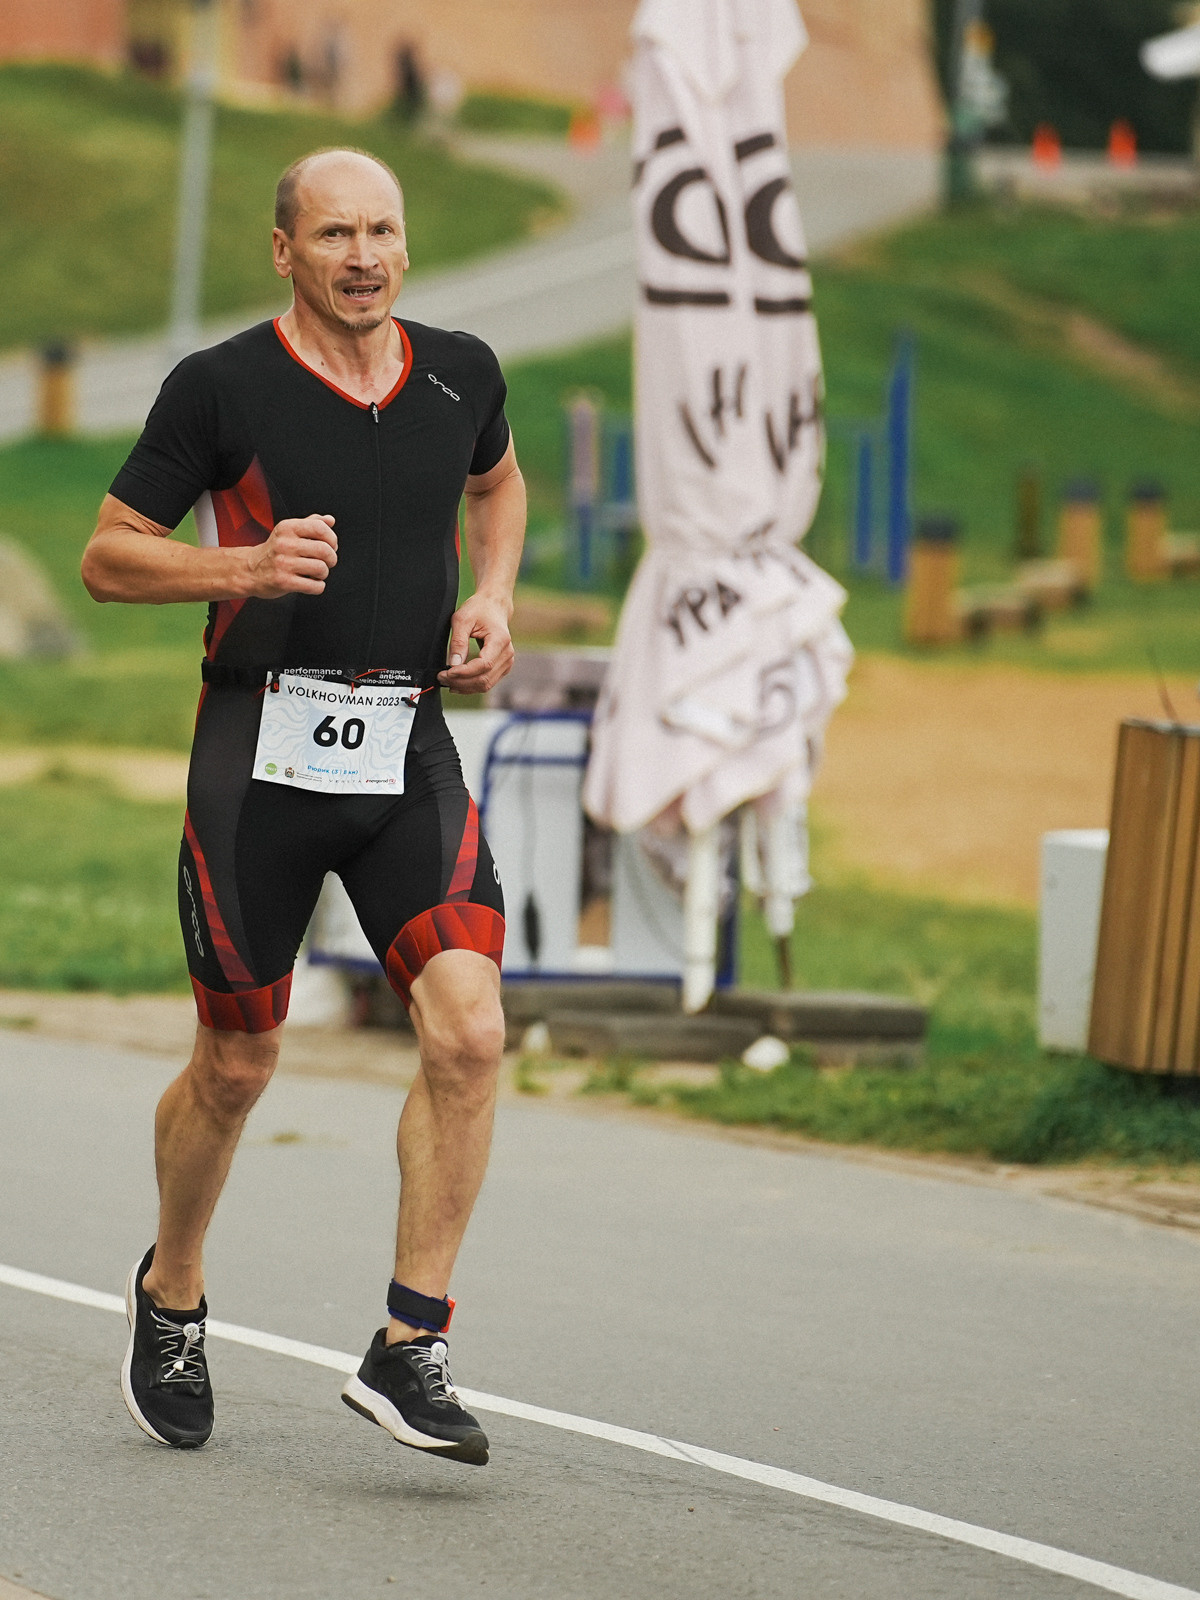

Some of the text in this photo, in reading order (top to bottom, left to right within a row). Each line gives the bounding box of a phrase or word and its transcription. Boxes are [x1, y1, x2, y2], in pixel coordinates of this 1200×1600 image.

[428, 374, 460, 401] orca
[284, 667, 343, 676] performance
[287, 685, 400, 706] VOLKHOVMAN 2023
[313, 715, 365, 750] 60
